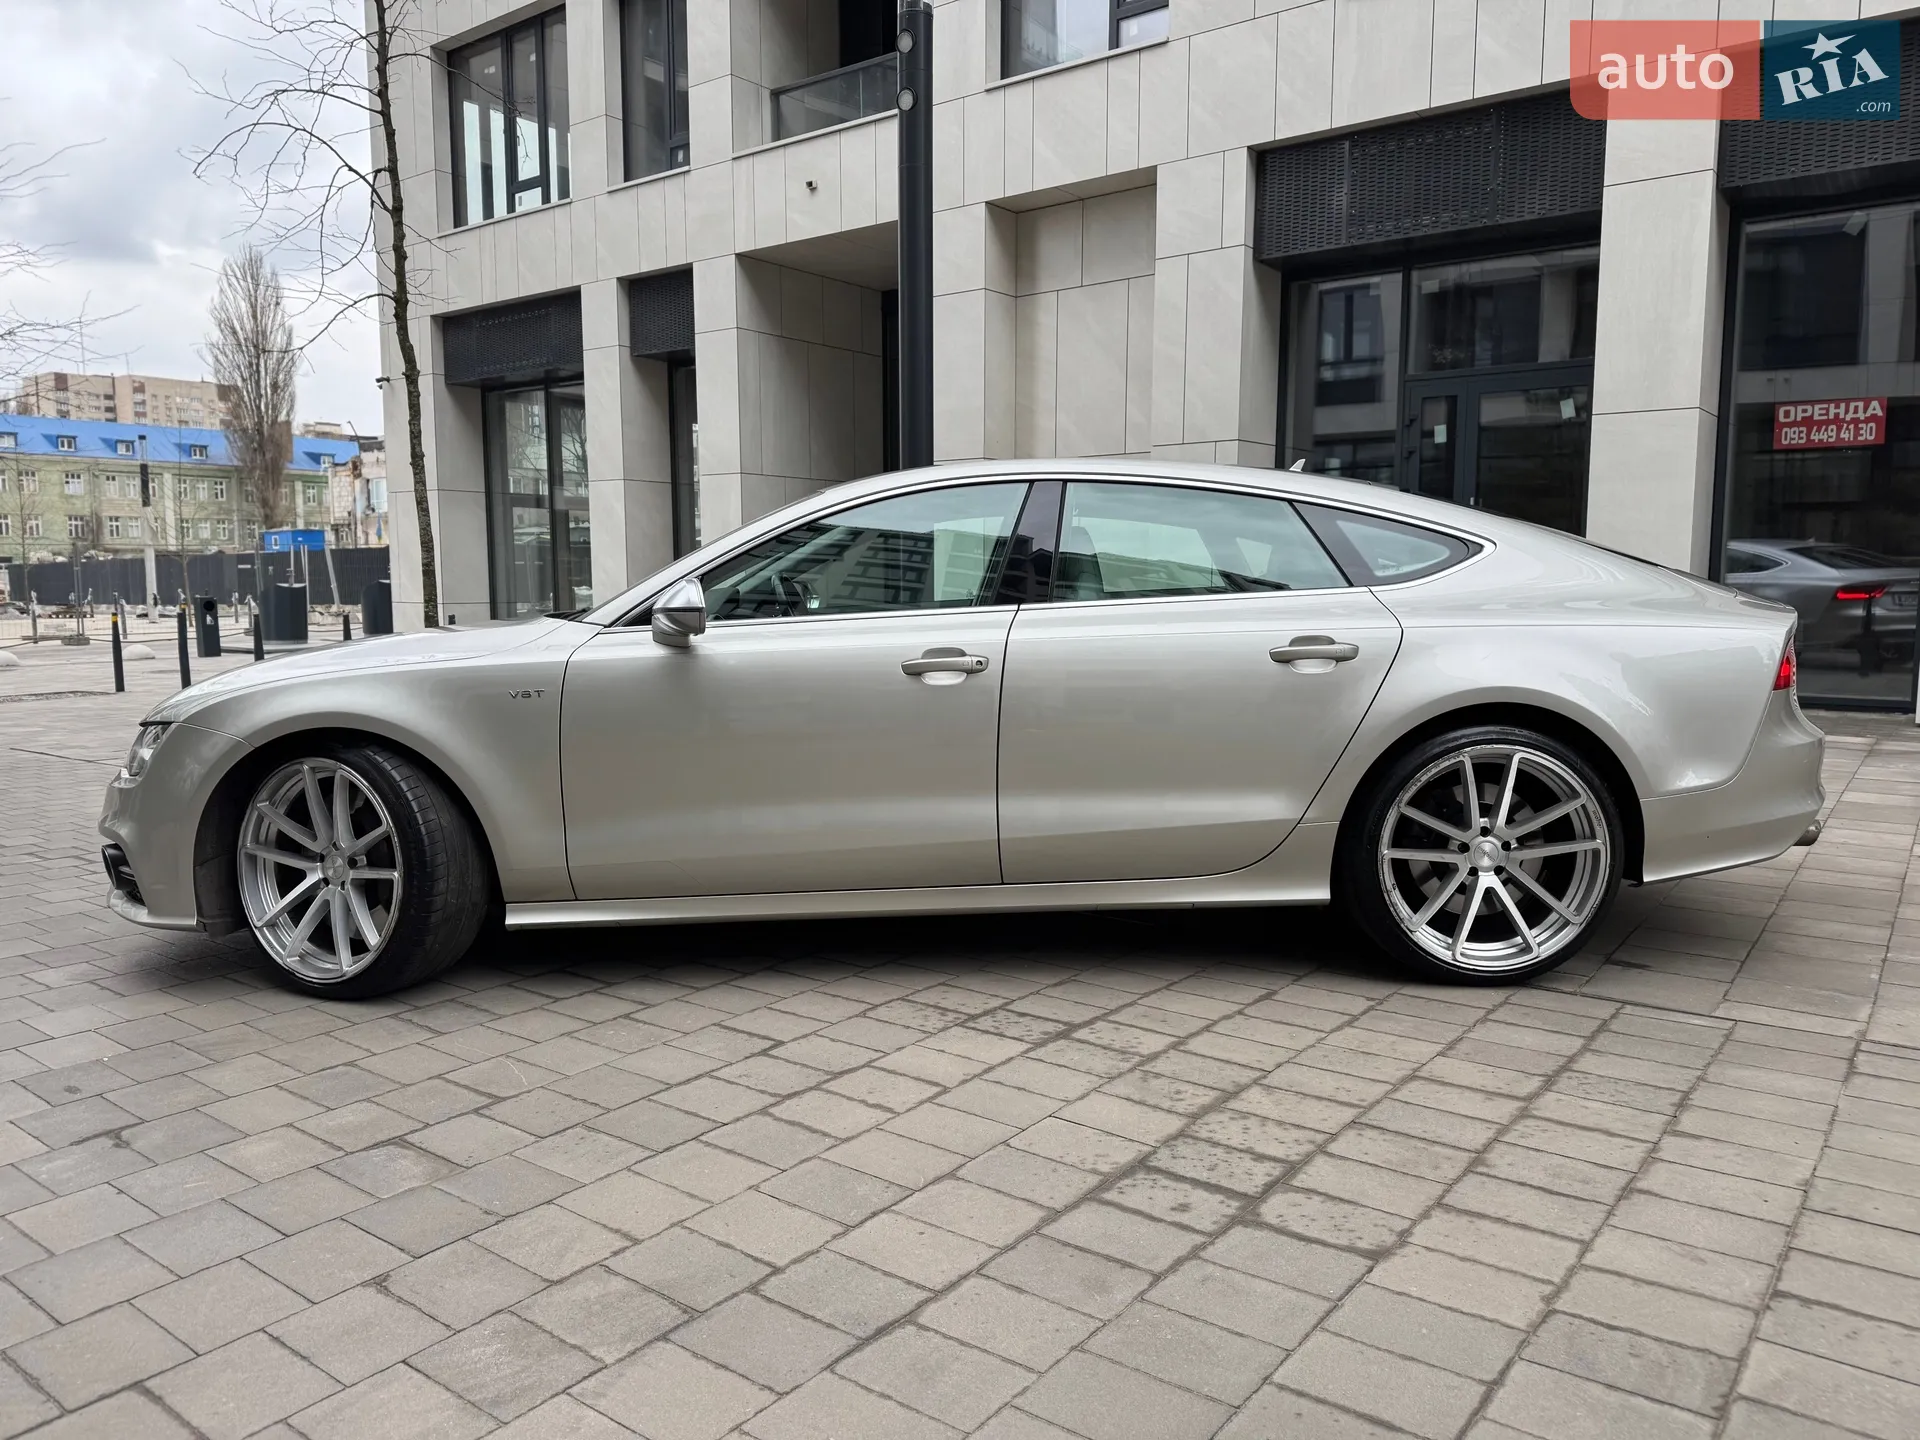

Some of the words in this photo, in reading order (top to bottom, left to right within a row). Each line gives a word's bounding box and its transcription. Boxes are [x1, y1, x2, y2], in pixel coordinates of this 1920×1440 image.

[1778, 400, 1884, 423] ОРЕНДА
[1781, 426, 1807, 445] 093
[1810, 424, 1837, 443] 449
[1840, 423, 1854, 441] 41
[1857, 422, 1876, 441] 30
